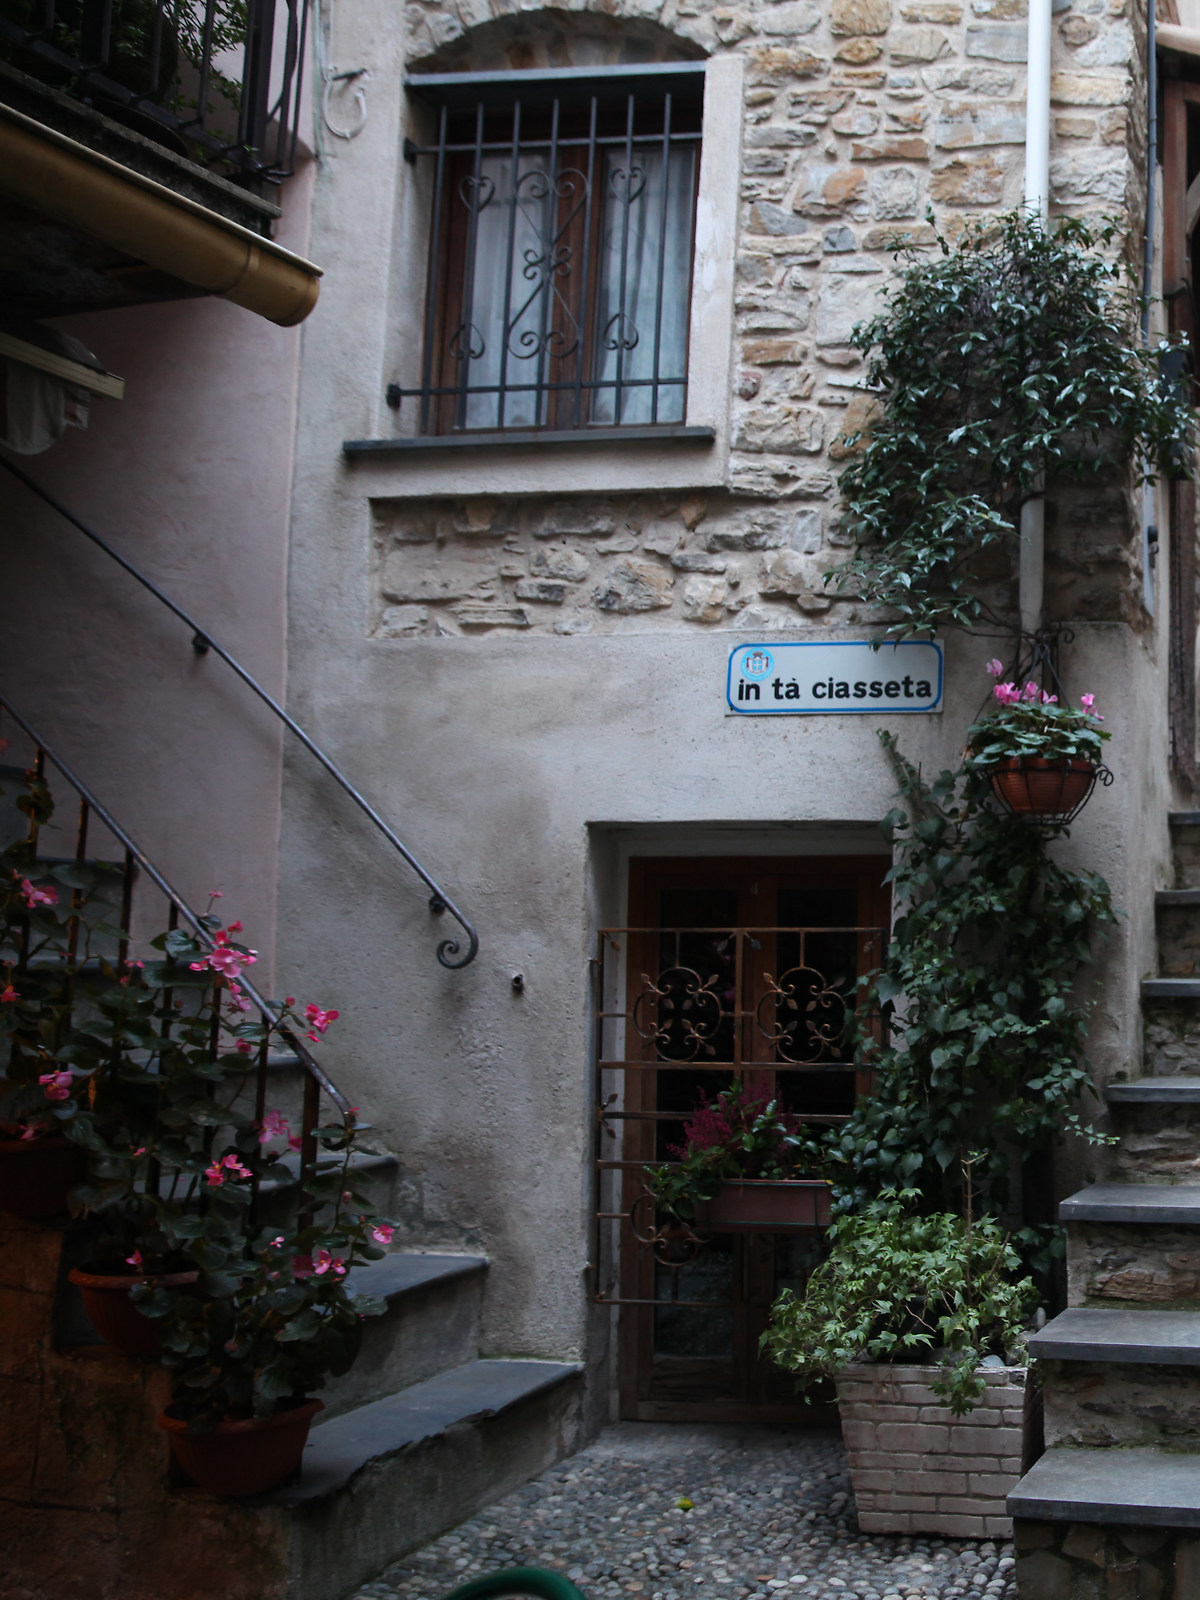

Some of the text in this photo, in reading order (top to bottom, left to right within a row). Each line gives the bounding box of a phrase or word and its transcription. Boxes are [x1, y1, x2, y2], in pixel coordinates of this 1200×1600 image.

[737, 675, 932, 701] in tà ciasseta
